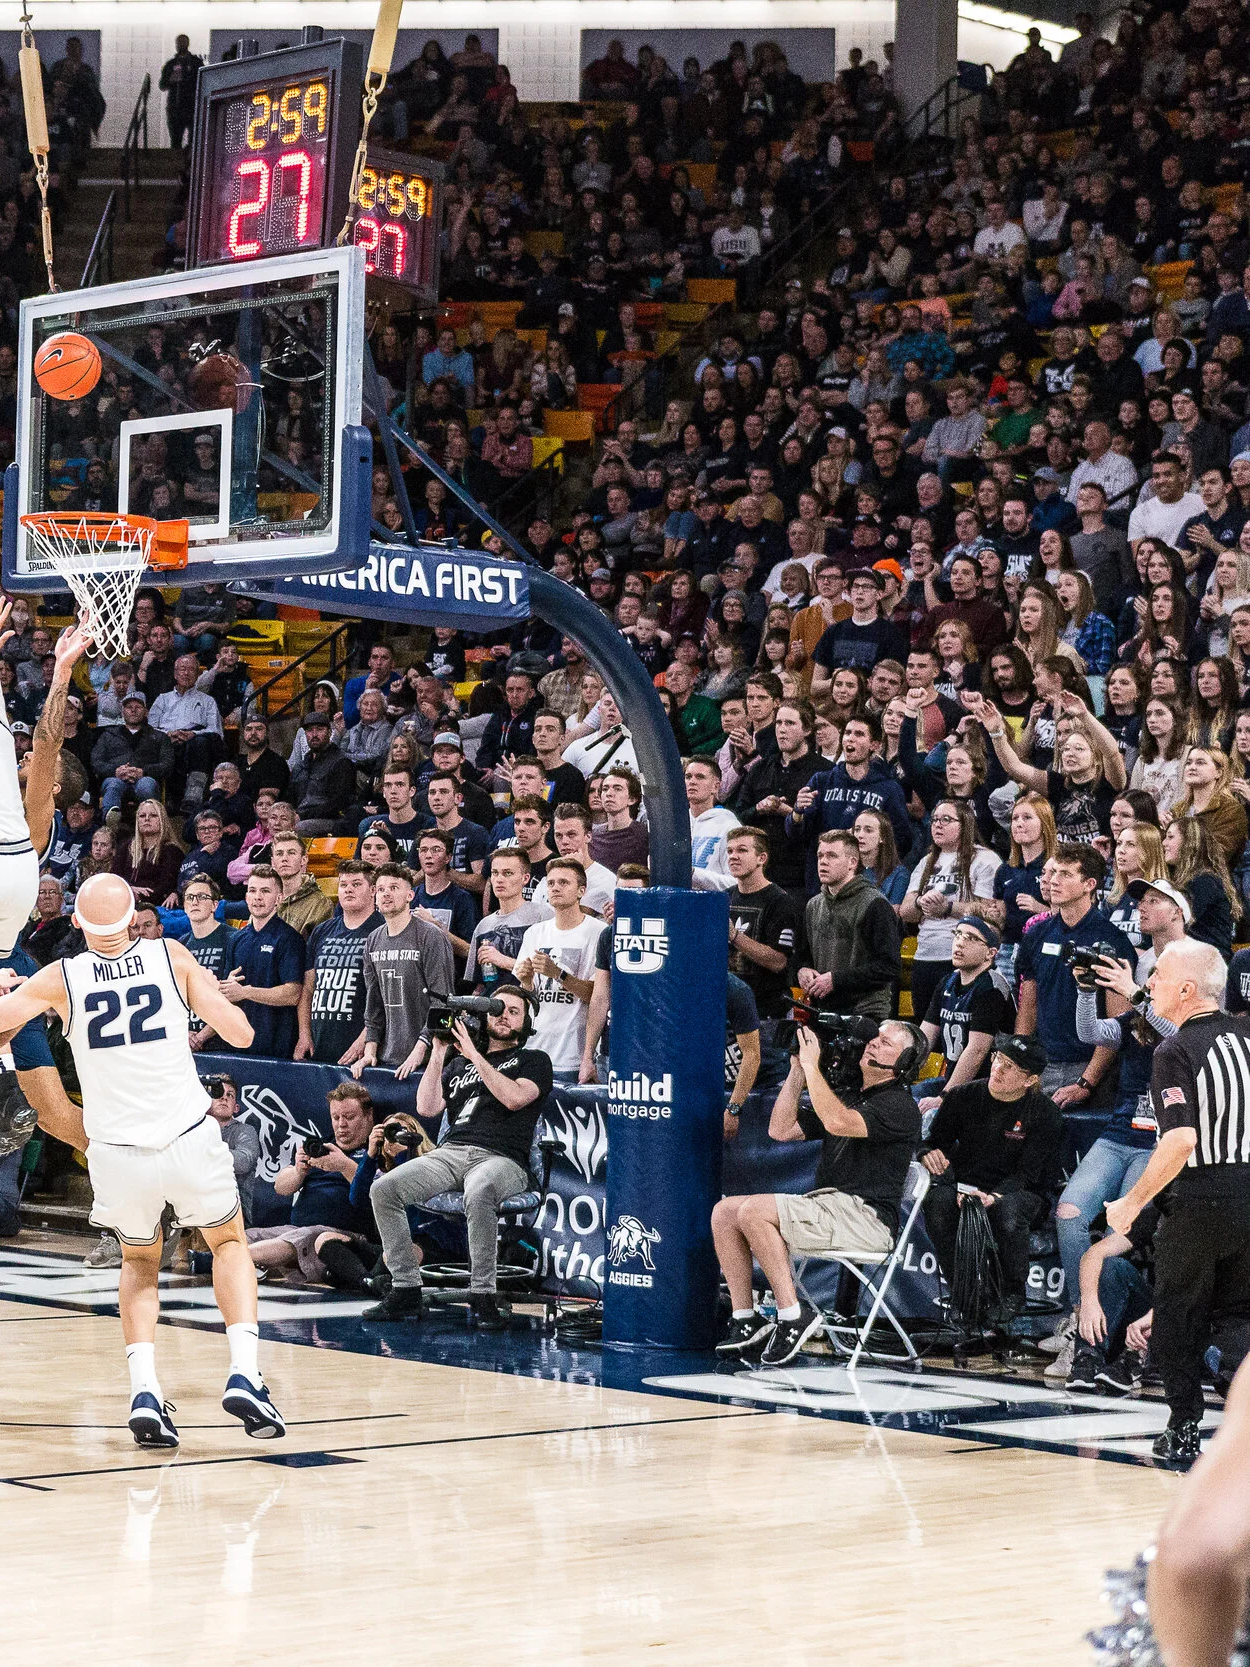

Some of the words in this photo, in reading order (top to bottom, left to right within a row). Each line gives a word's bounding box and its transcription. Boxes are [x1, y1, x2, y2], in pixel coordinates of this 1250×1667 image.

[247, 82, 328, 150] 2:59
[229, 151, 312, 257] 27
[358, 168, 427, 217] 2:59
[358, 217, 405, 275] 27
[436, 563, 522, 605] FIRST
[400, 949, 420, 961] STATE
[614, 935, 669, 956] STATE
[93, 955, 145, 983] MILLER
[316, 969, 360, 990] TRUE
[311, 990, 355, 1013] BLUE
[539, 991, 575, 1004] GGIES
[85, 984, 167, 1049] 22
[608, 1070, 672, 1102] Guild
[607, 1102, 672, 1120] mortgage
[608, 1271, 653, 1288] AGGIES
